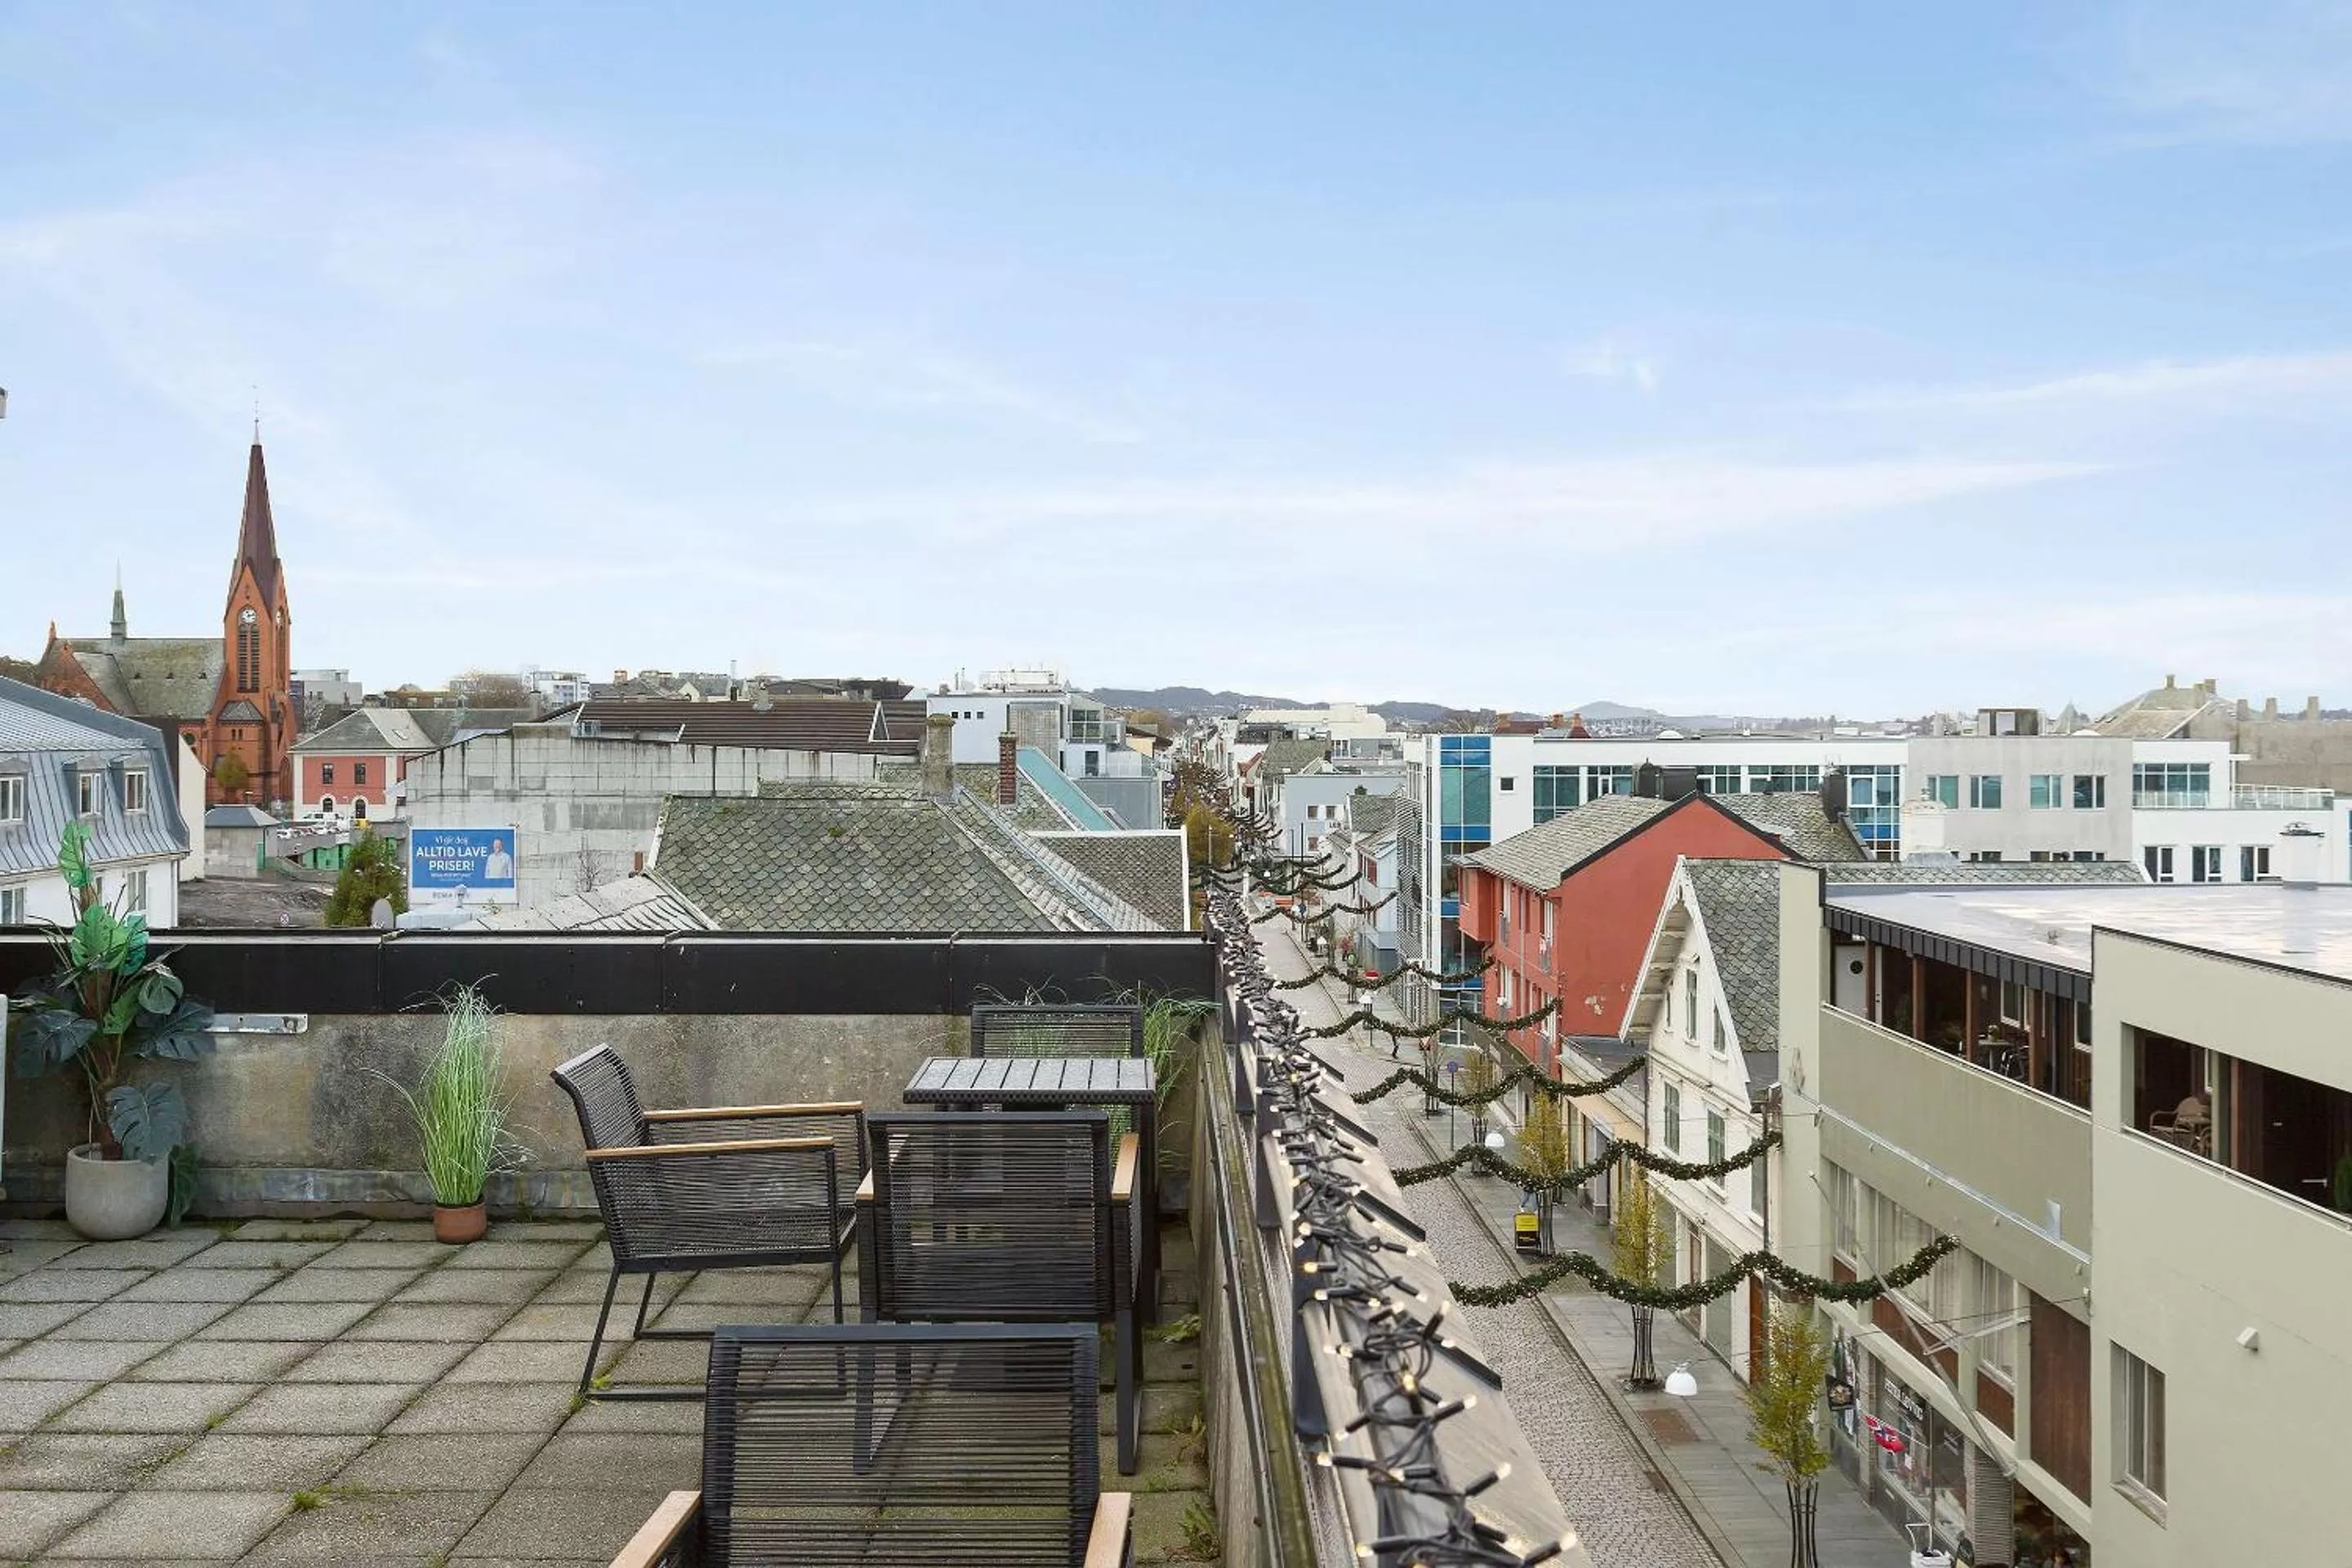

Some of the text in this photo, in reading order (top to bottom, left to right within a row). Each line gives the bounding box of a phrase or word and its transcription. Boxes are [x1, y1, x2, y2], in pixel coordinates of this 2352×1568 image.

[416, 846, 488, 857] ALLTID LAVE
[429, 860, 474, 871] PRISER!
